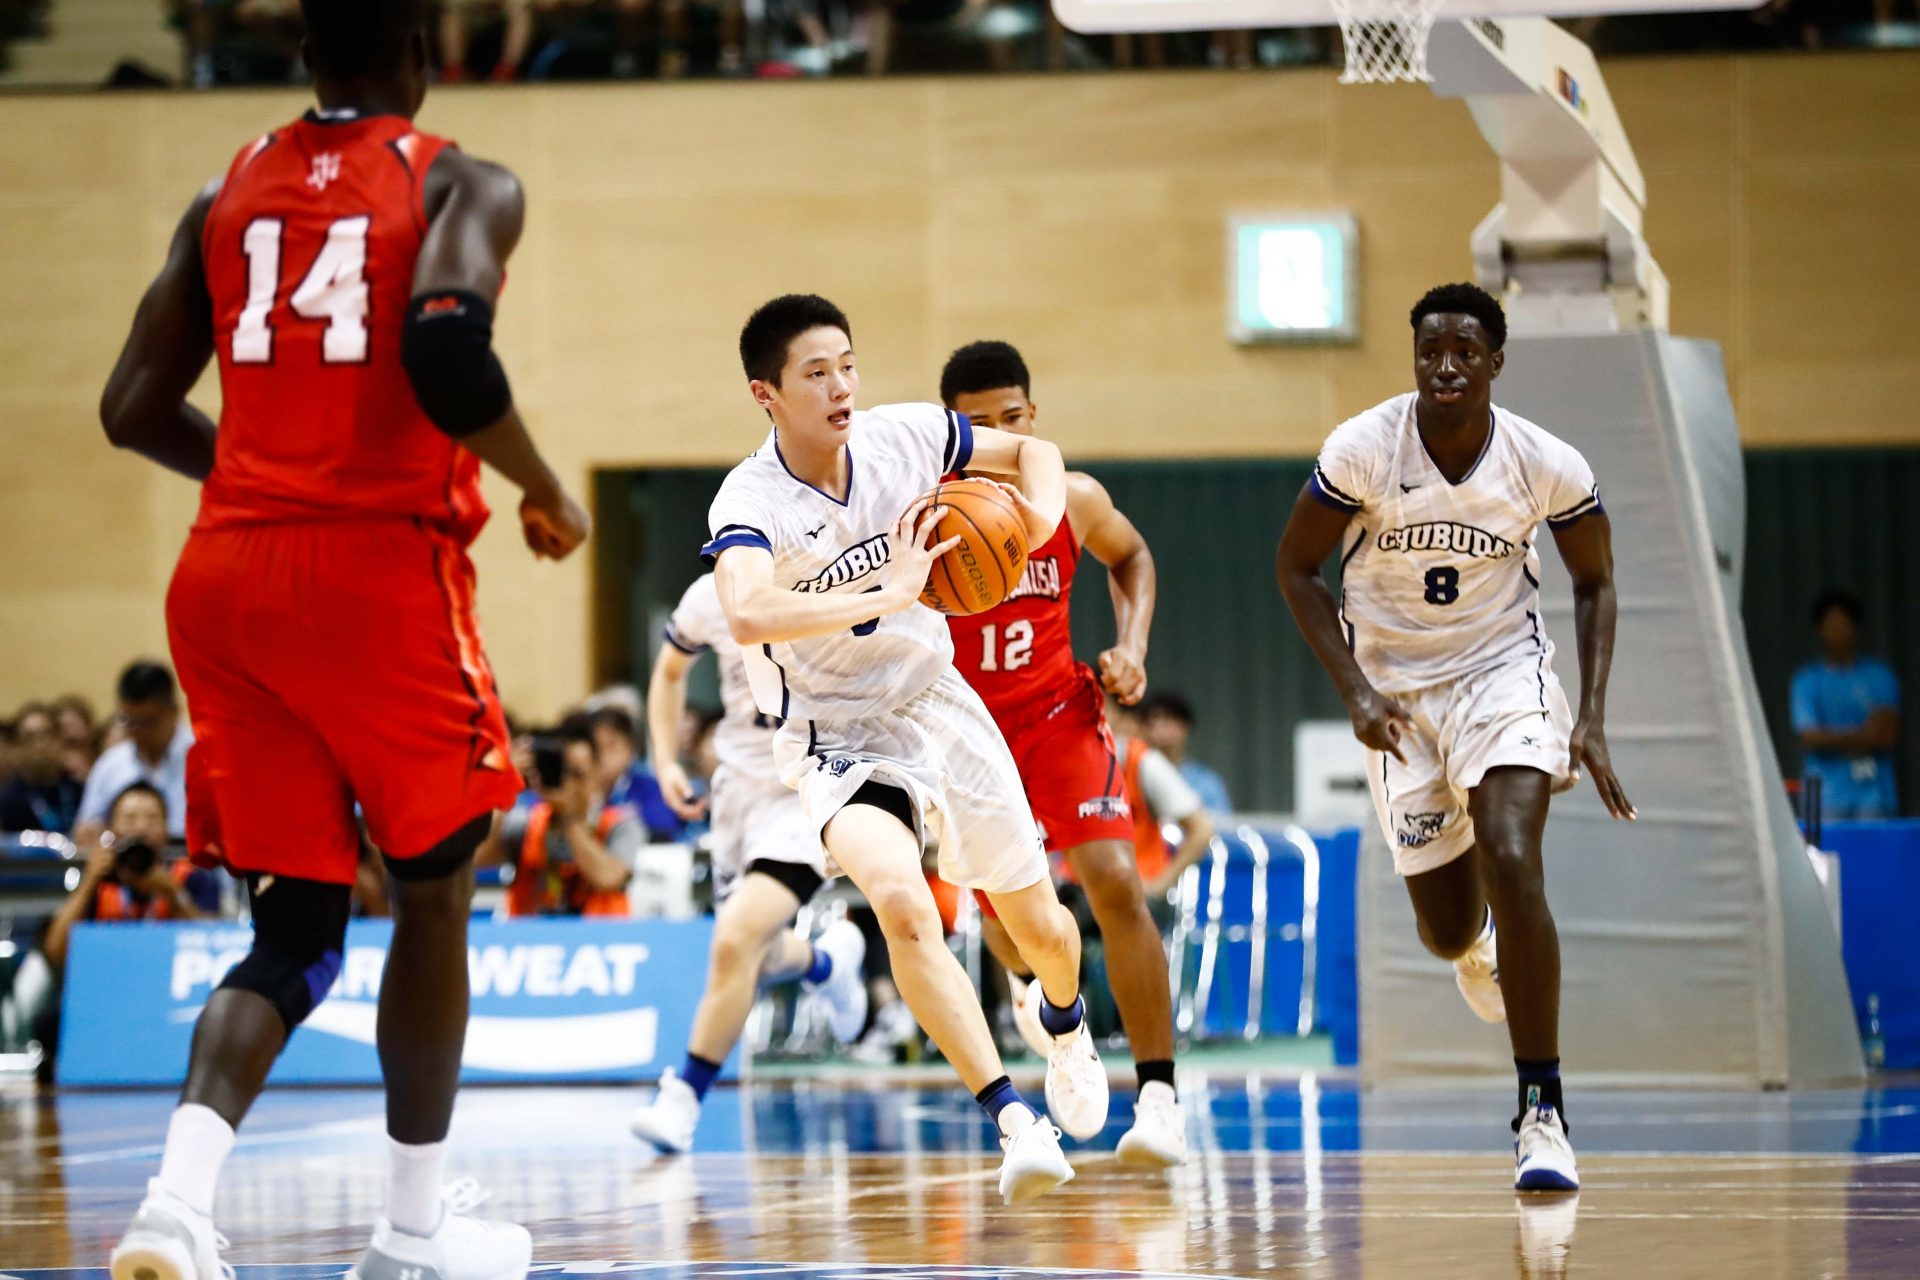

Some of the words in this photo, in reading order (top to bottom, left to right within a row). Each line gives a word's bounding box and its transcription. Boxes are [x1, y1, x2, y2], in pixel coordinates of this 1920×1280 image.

[230, 214, 371, 364] 14
[1423, 566, 1460, 606] 8
[979, 618, 1035, 673] 12
[466, 943, 650, 997] WEAT
